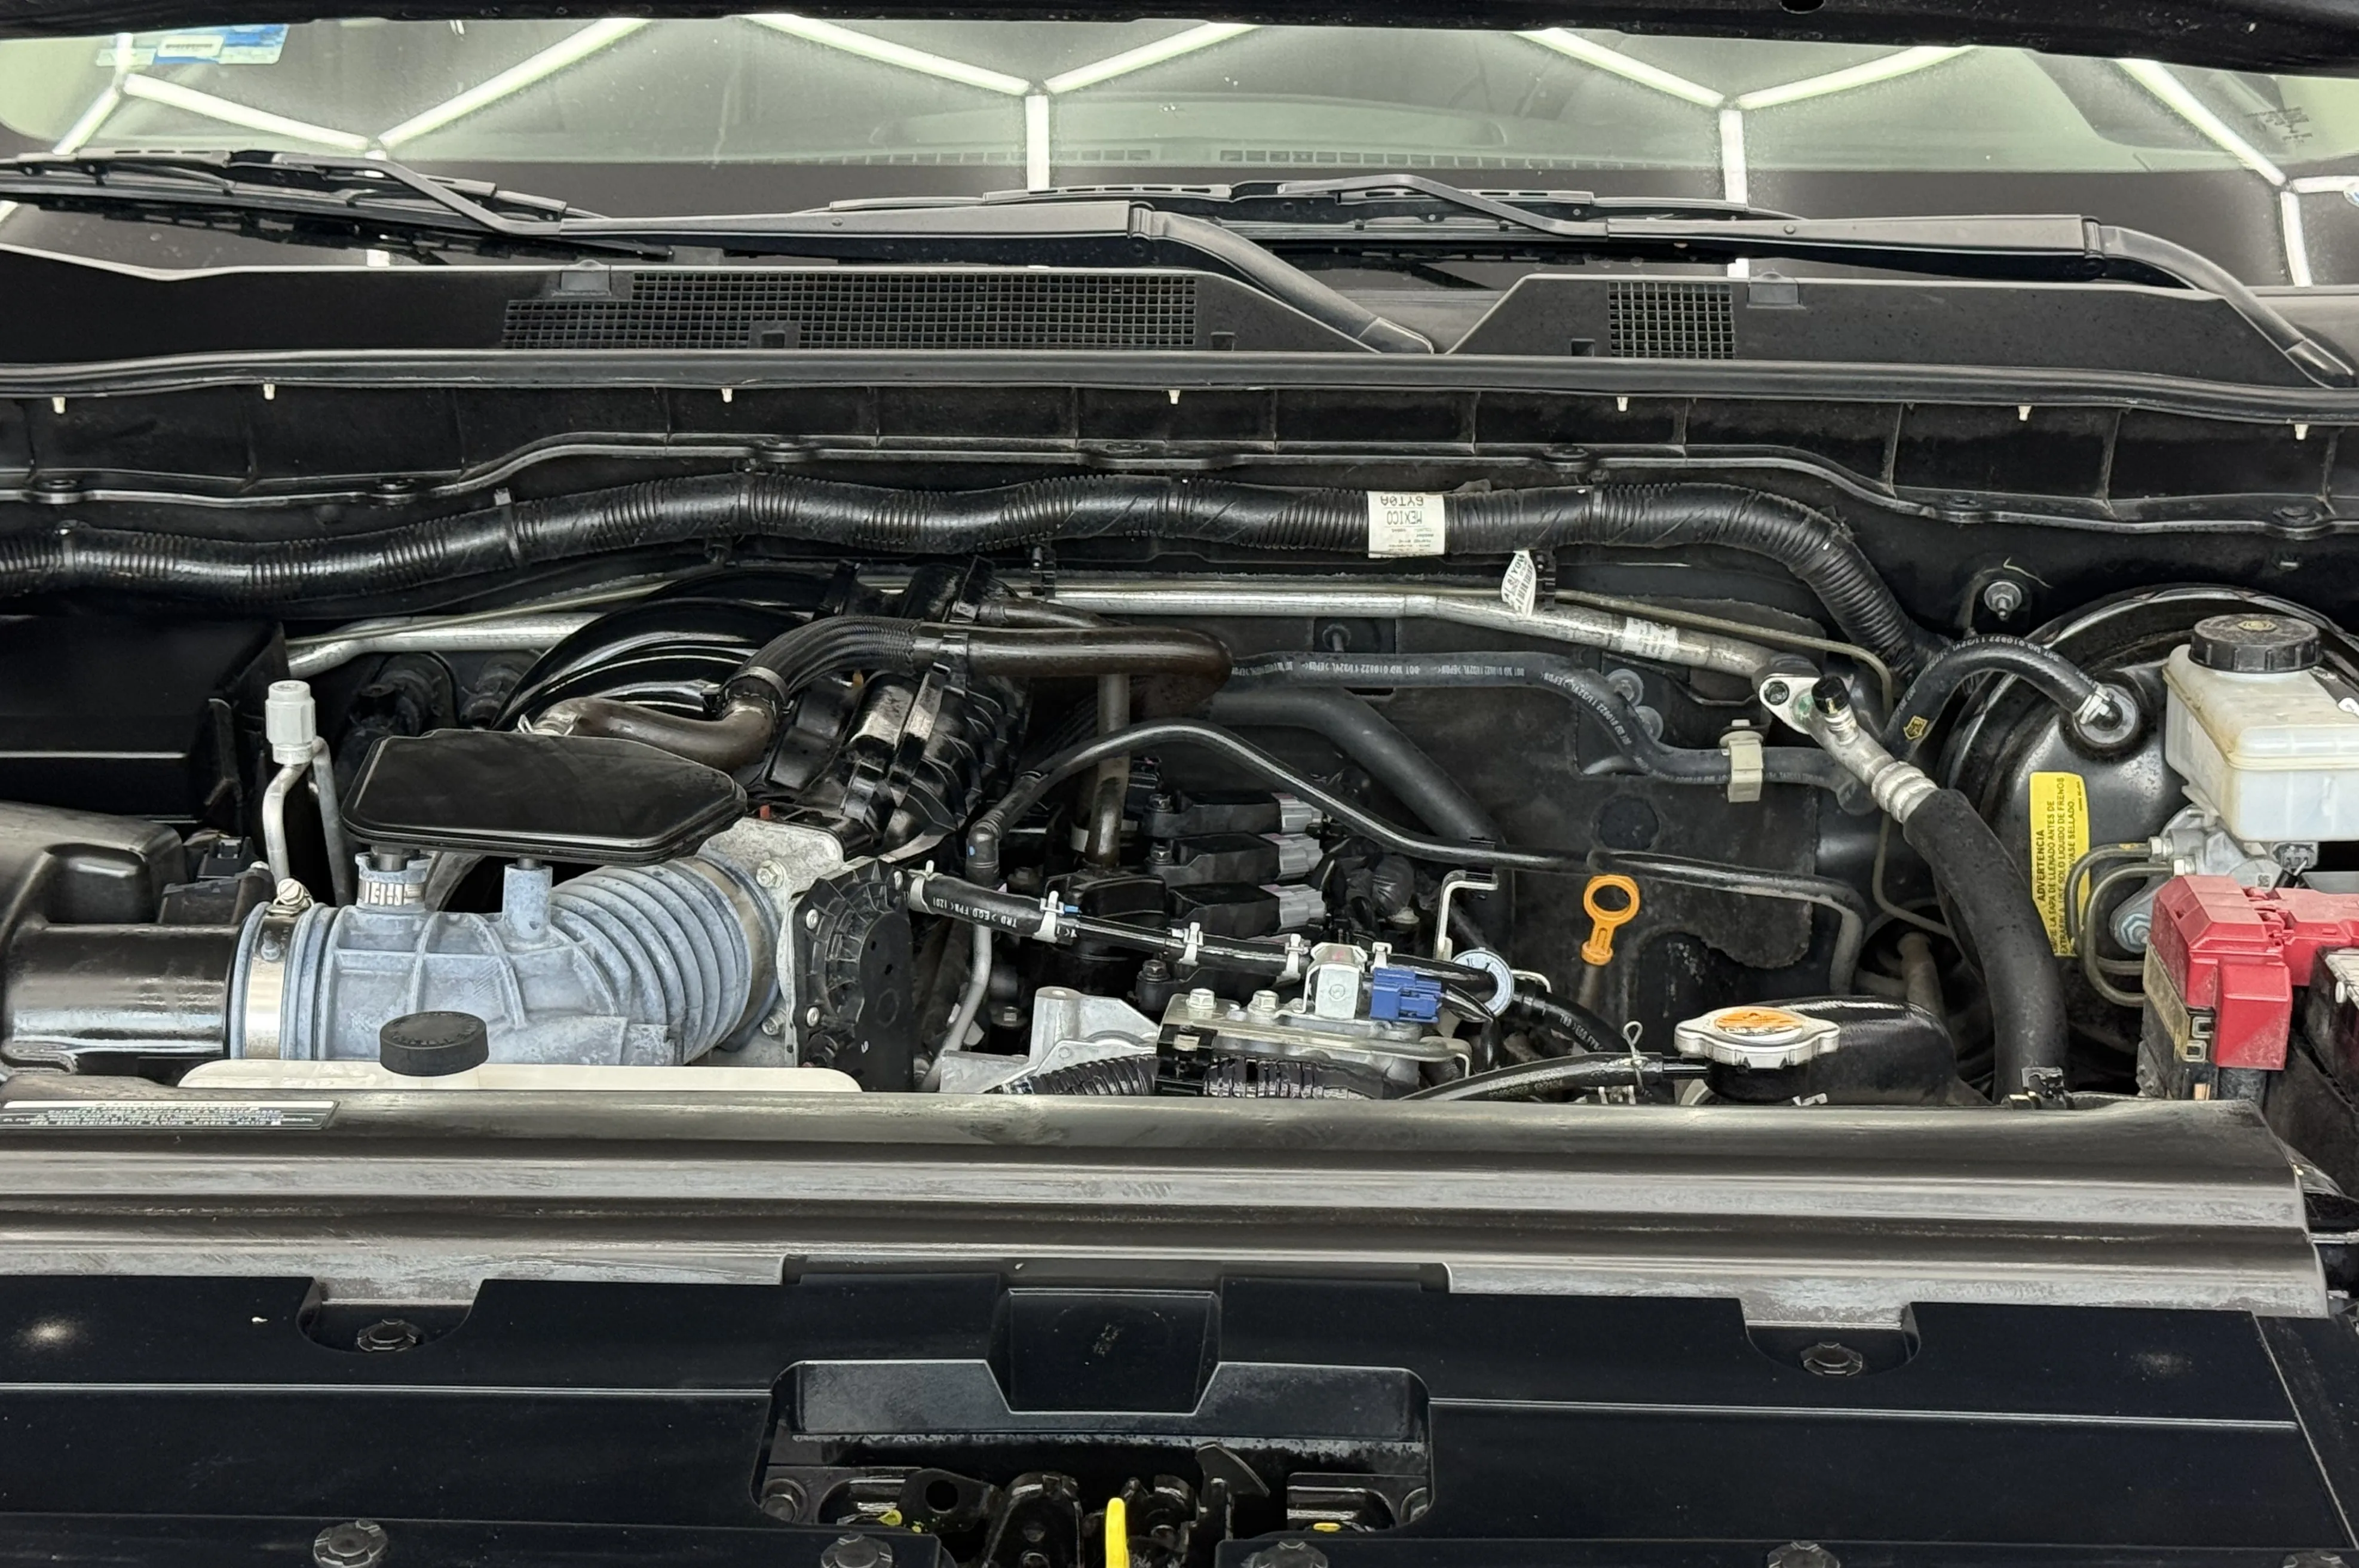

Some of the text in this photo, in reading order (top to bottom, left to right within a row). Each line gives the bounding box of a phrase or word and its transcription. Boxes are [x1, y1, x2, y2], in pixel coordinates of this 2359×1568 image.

[1387, 510, 1422, 525] MEXICO
[2046, 800, 2054, 812] DE
[2046, 814, 2055, 840] ANTES
[2057, 813, 2065, 824] DE
[2036, 830, 2045, 901] ADVERTENCIA
[2047, 842, 2055, 880] LLENADO
